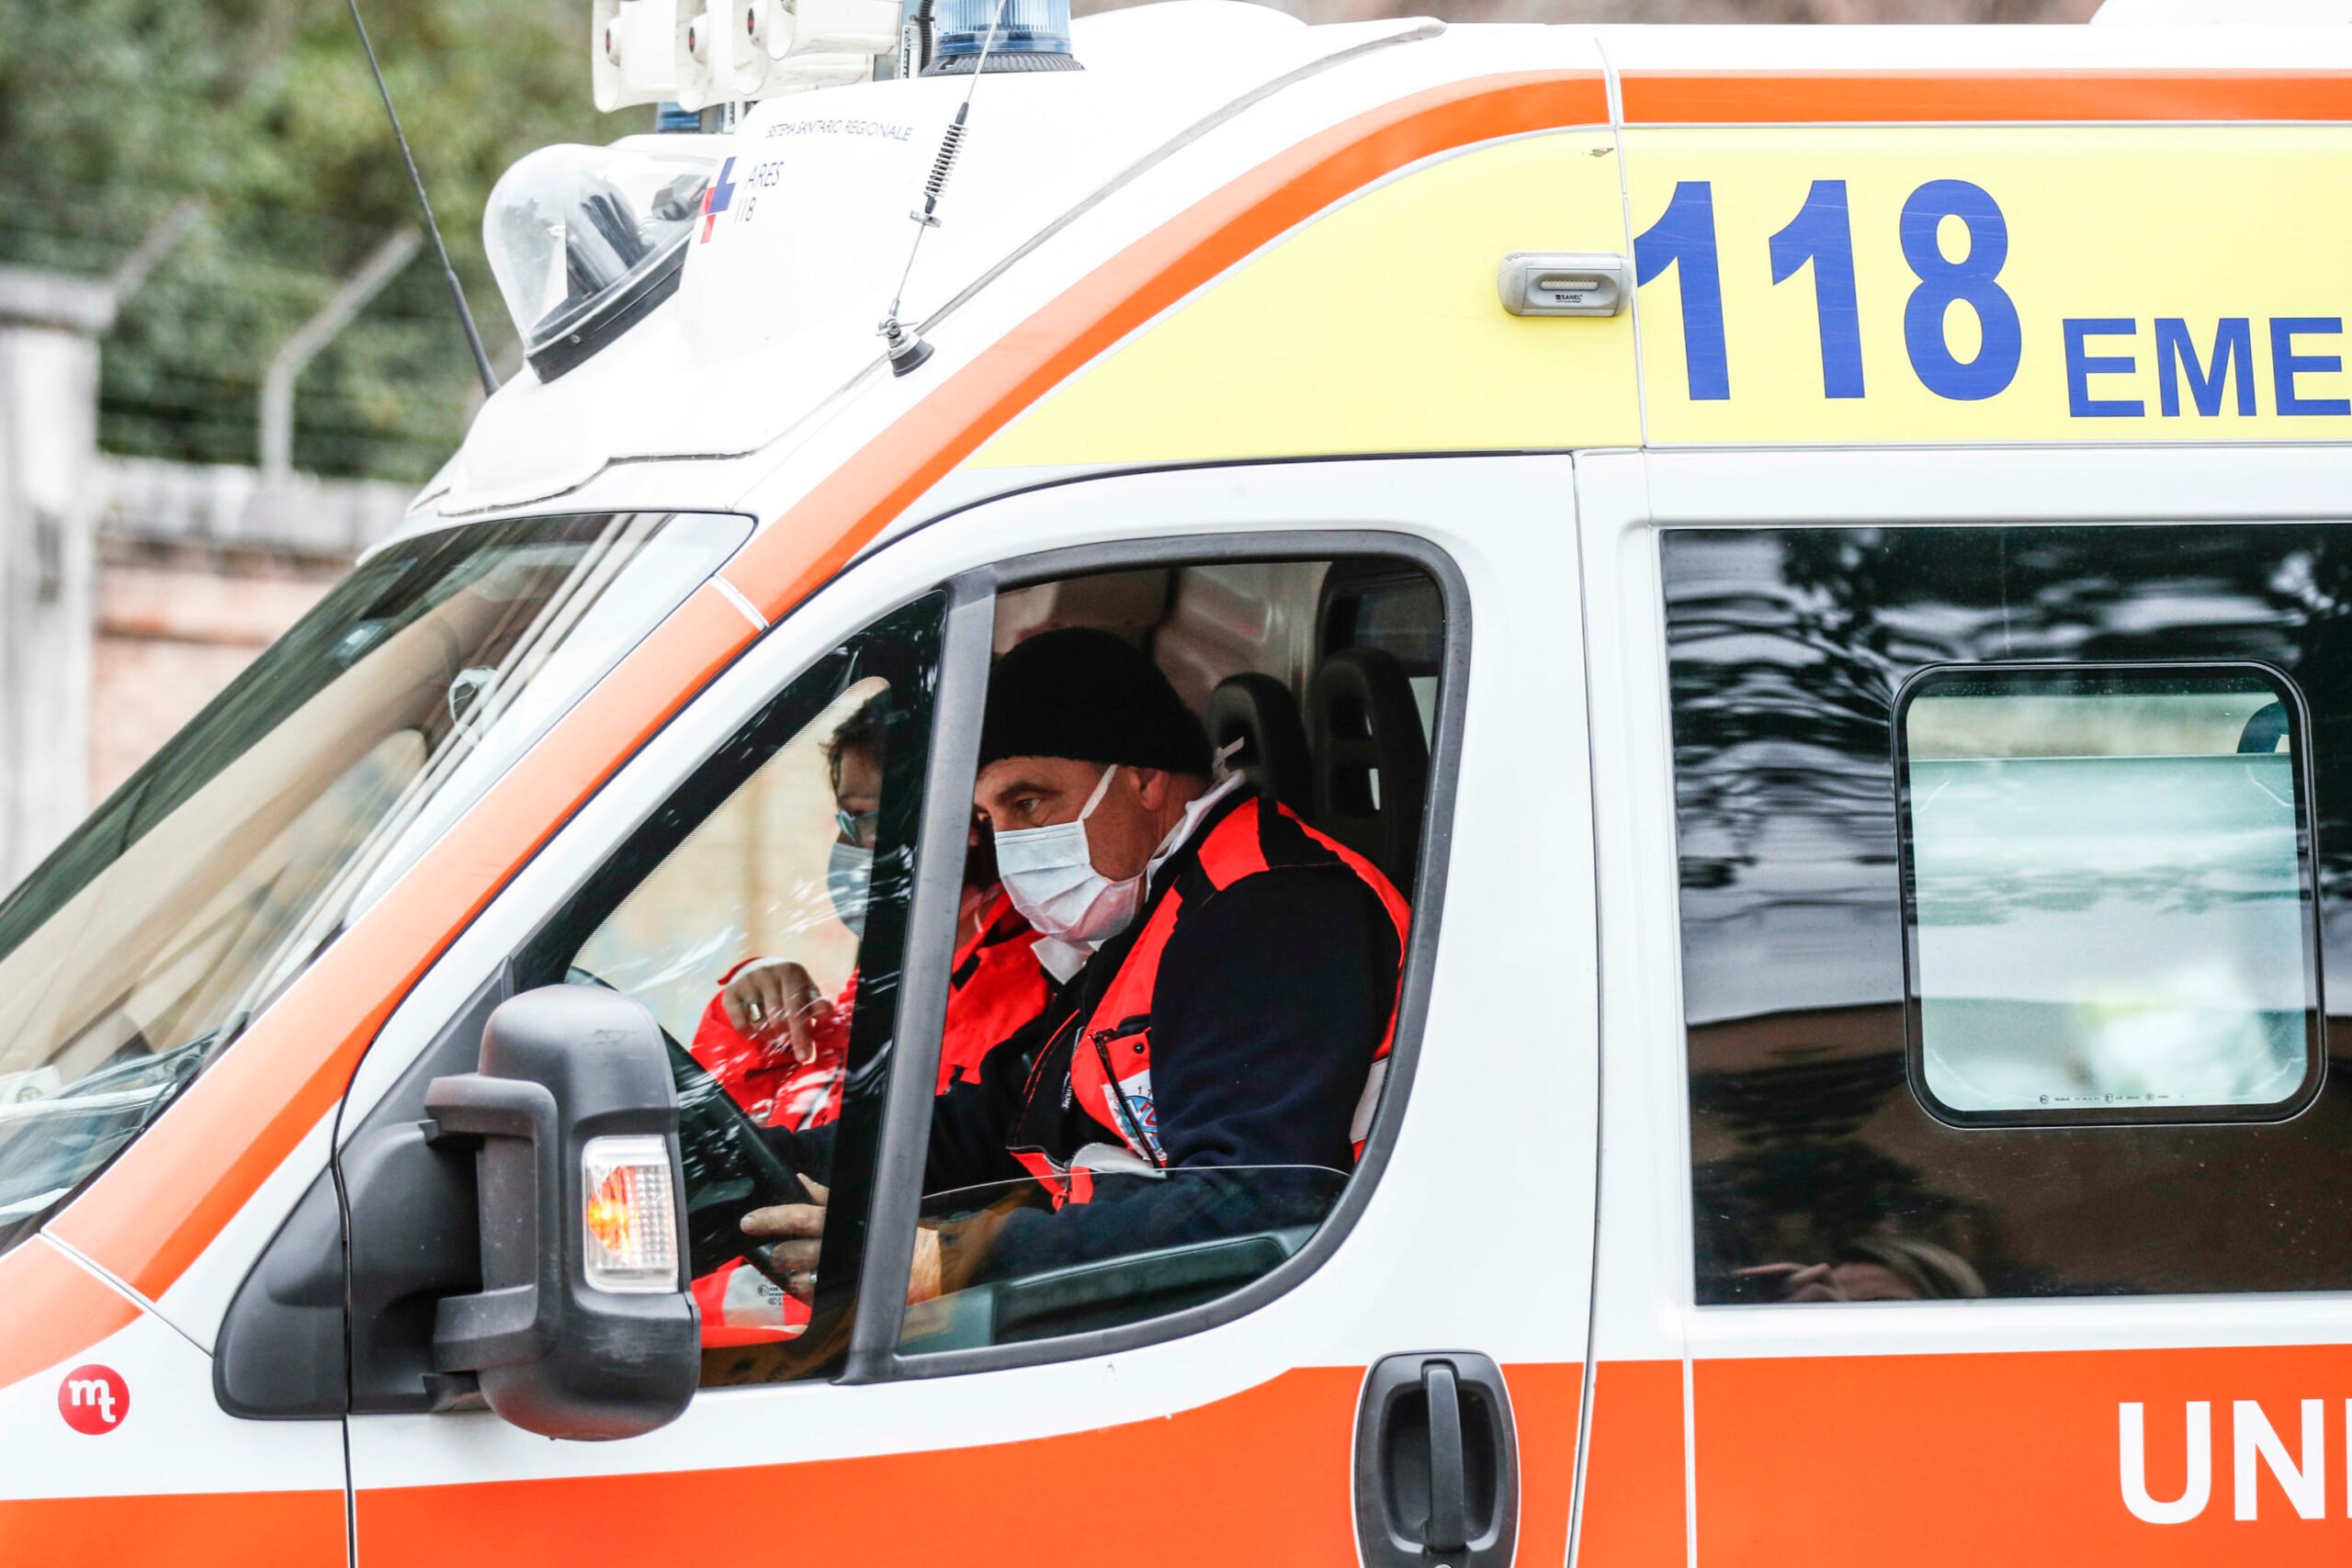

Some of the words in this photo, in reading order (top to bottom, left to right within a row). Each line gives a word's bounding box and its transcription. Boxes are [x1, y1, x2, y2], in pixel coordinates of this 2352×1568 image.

[765, 123, 797, 139] SISTEMA
[796, 118, 843, 134] SANITARIO
[844, 118, 914, 142] REGIONALE
[744, 161, 784, 189] ARES
[733, 196, 757, 224] 118
[1634, 179, 2021, 400] 118
[2062, 317, 2352, 417] EME
